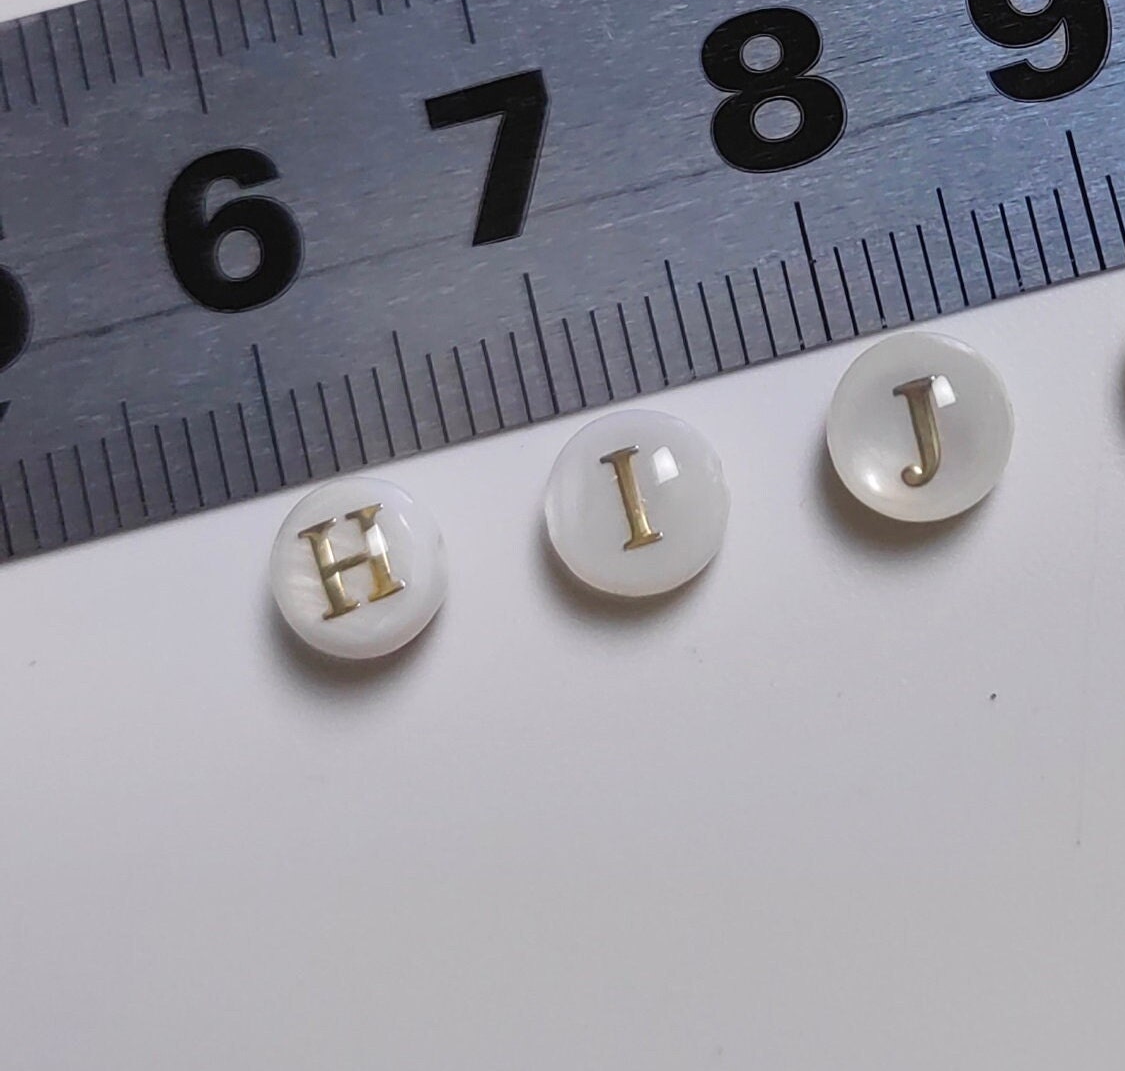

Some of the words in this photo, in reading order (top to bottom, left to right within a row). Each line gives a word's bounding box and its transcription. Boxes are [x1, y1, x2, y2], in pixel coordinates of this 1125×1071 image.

[163, 147, 305, 313] 6
[425, 70, 550, 246] 7
[700, 6, 847, 173] 8
[892, 375, 942, 488] J
[600, 445, 664, 551] I
[298, 503, 407, 622] H
